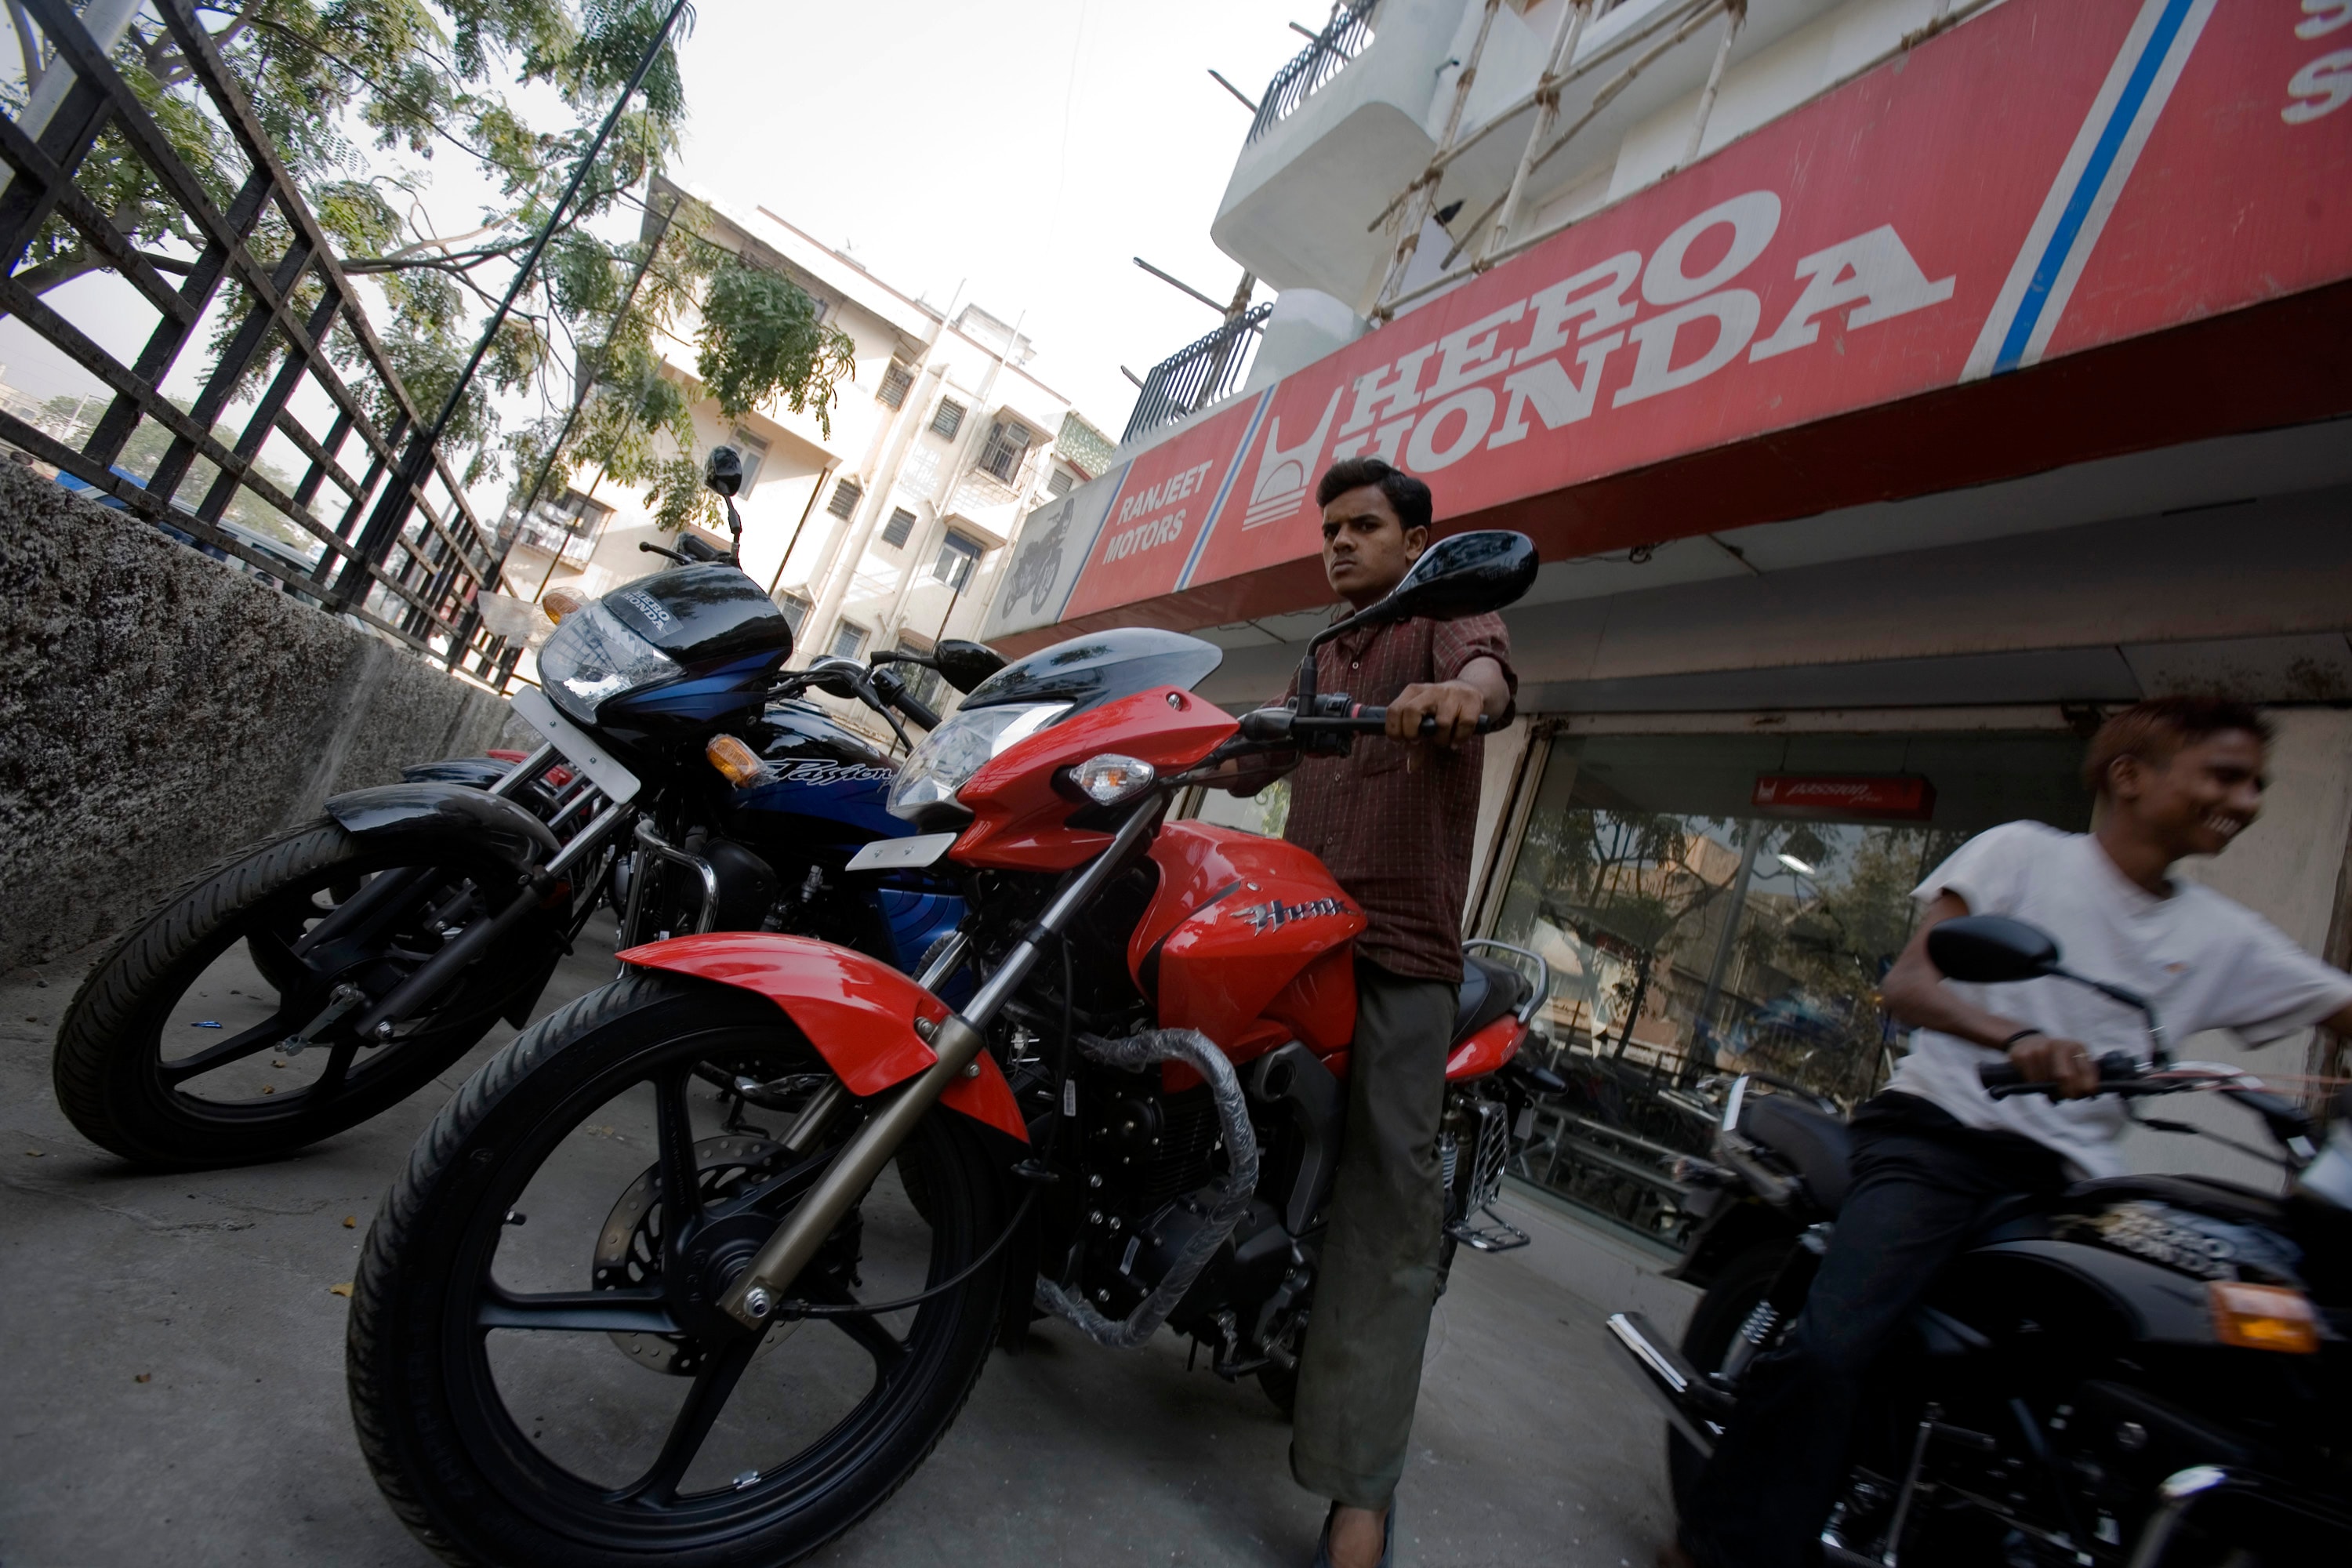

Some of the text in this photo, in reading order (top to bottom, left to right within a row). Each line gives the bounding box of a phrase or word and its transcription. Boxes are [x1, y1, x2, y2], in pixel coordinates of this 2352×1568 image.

[1340, 190, 1782, 436] HERO
[1331, 224, 1957, 473] HONDA
[1116, 459, 1214, 526] RANJEET
[1102, 508, 1187, 565] MOTORS
[622, 592, 664, 632] HONDA
[632, 590, 670, 622] HERO
